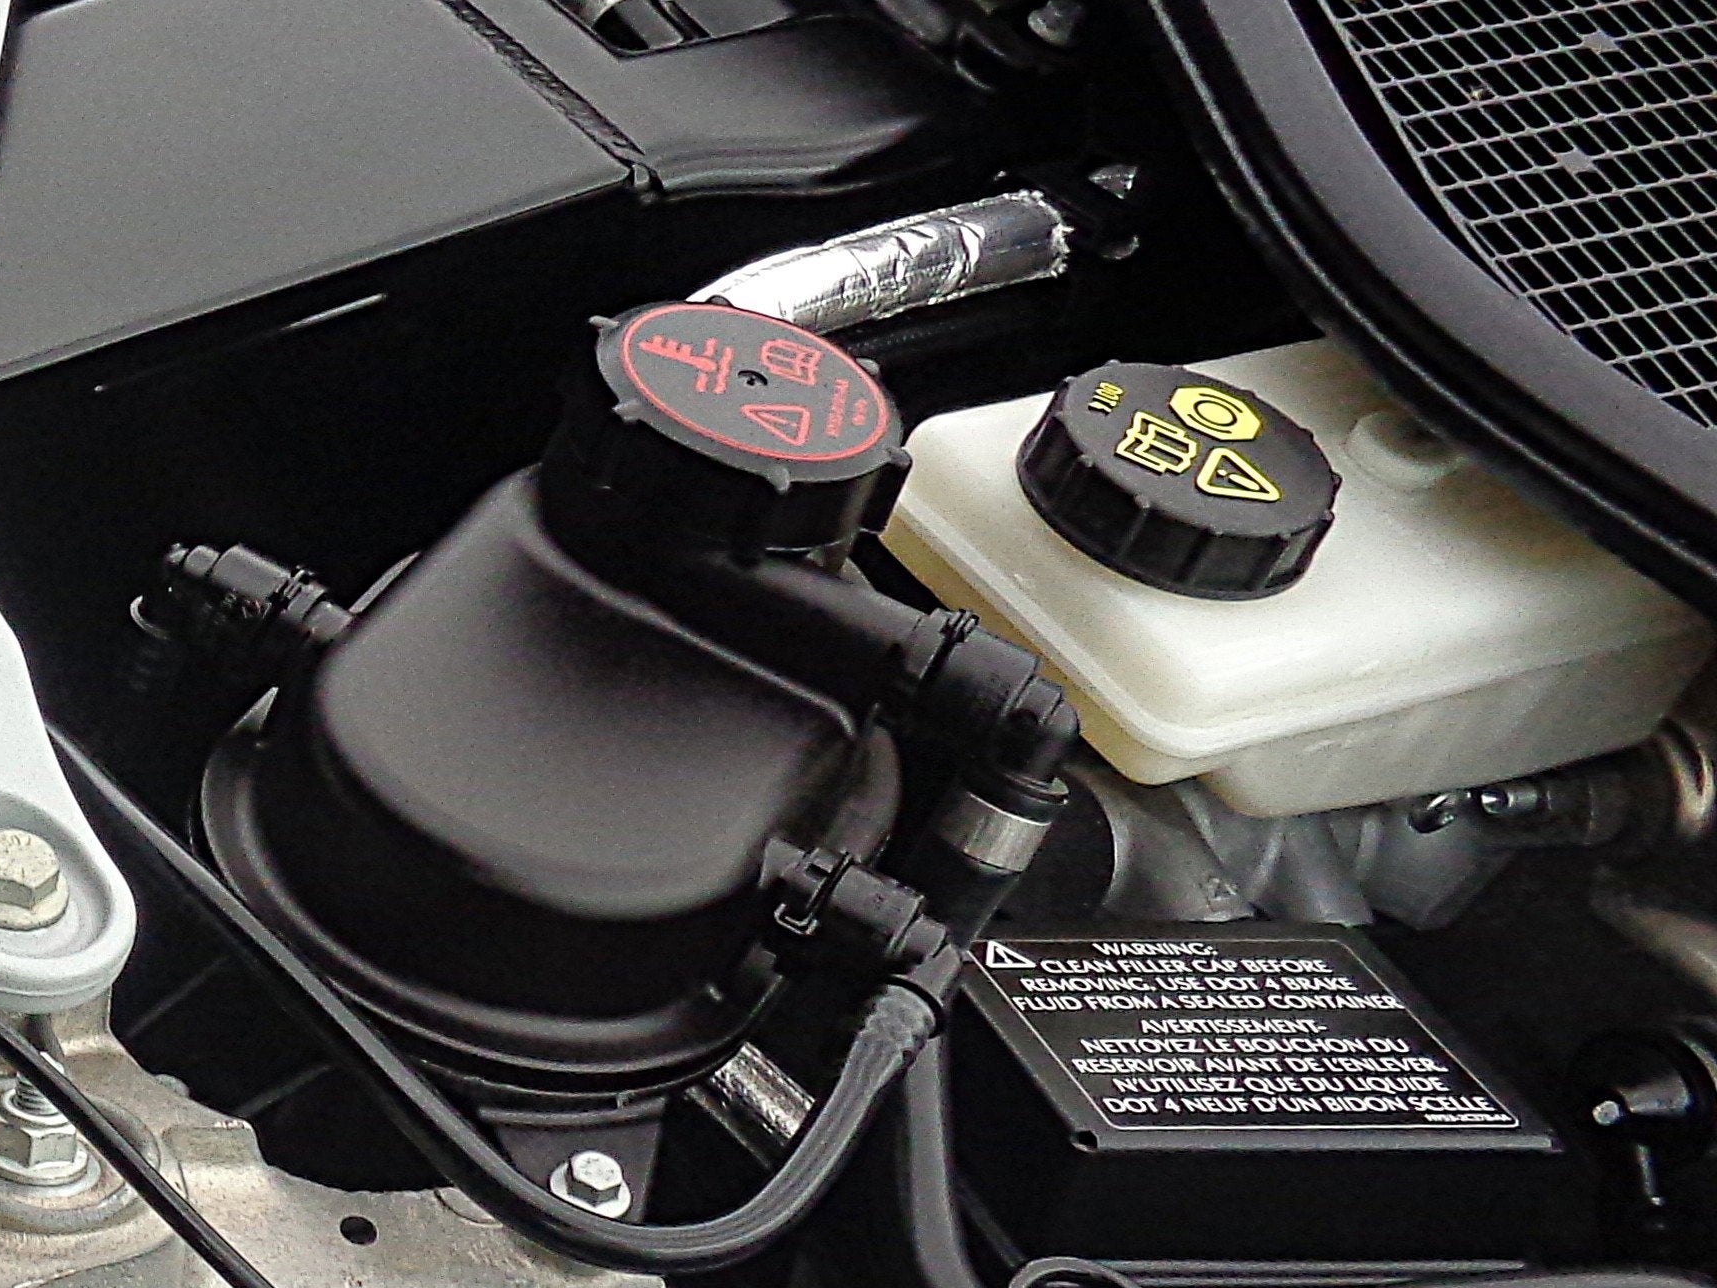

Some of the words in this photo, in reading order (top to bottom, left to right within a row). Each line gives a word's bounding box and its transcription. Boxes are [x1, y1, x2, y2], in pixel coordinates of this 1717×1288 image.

[1091, 942, 1219, 957] WARNING:
[1039, 959, 1119, 974] CLEAN
[1116, 959, 1193, 974] FILLER
[1191, 959, 1239, 974] CAP
[1239, 959, 1333, 974] BEFORE
[1154, 976, 1211, 992] USE
[1203, 977, 1261, 991] DOT
[1279, 976, 1358, 992] BRAKE
[1012, 994, 1085, 1012] FLUID
[1083, 994, 1159, 1011] FROM
[1160, 995, 1181, 1010] A
[1178, 994, 1267, 1010] SEALED
[1266, 994, 1406, 1010] CONTAINER
[1078, 1038, 1206, 1054] NETTOYEZ
[1202, 1038, 1237, 1054] LE
[1233, 1037, 1369, 1054] BOUCHON
[1366, 1037, 1411, 1054] DU
[1071, 1057, 1203, 1074] RESERVOIR
[1203, 1057, 1283, 1073] AVANT
[1283, 1057, 1325, 1073] DE
[1111, 1076, 1246, 1093] N'UTILISEZ
[1243, 1076, 1304, 1096] QUE
[1300, 1076, 1346, 1092] DU
[1343, 1076, 1451, 1095] LIQUIDE
[1102, 1096, 1160, 1114] DOT
[1163, 1096, 1182, 1113] 4
[1179, 1097, 1249, 1113] NEUF
[1250, 1096, 1324, 1113] D'UN
[1320, 1096, 1410, 1113] BIDON
[1407, 1096, 1497, 1112] SCELLE
